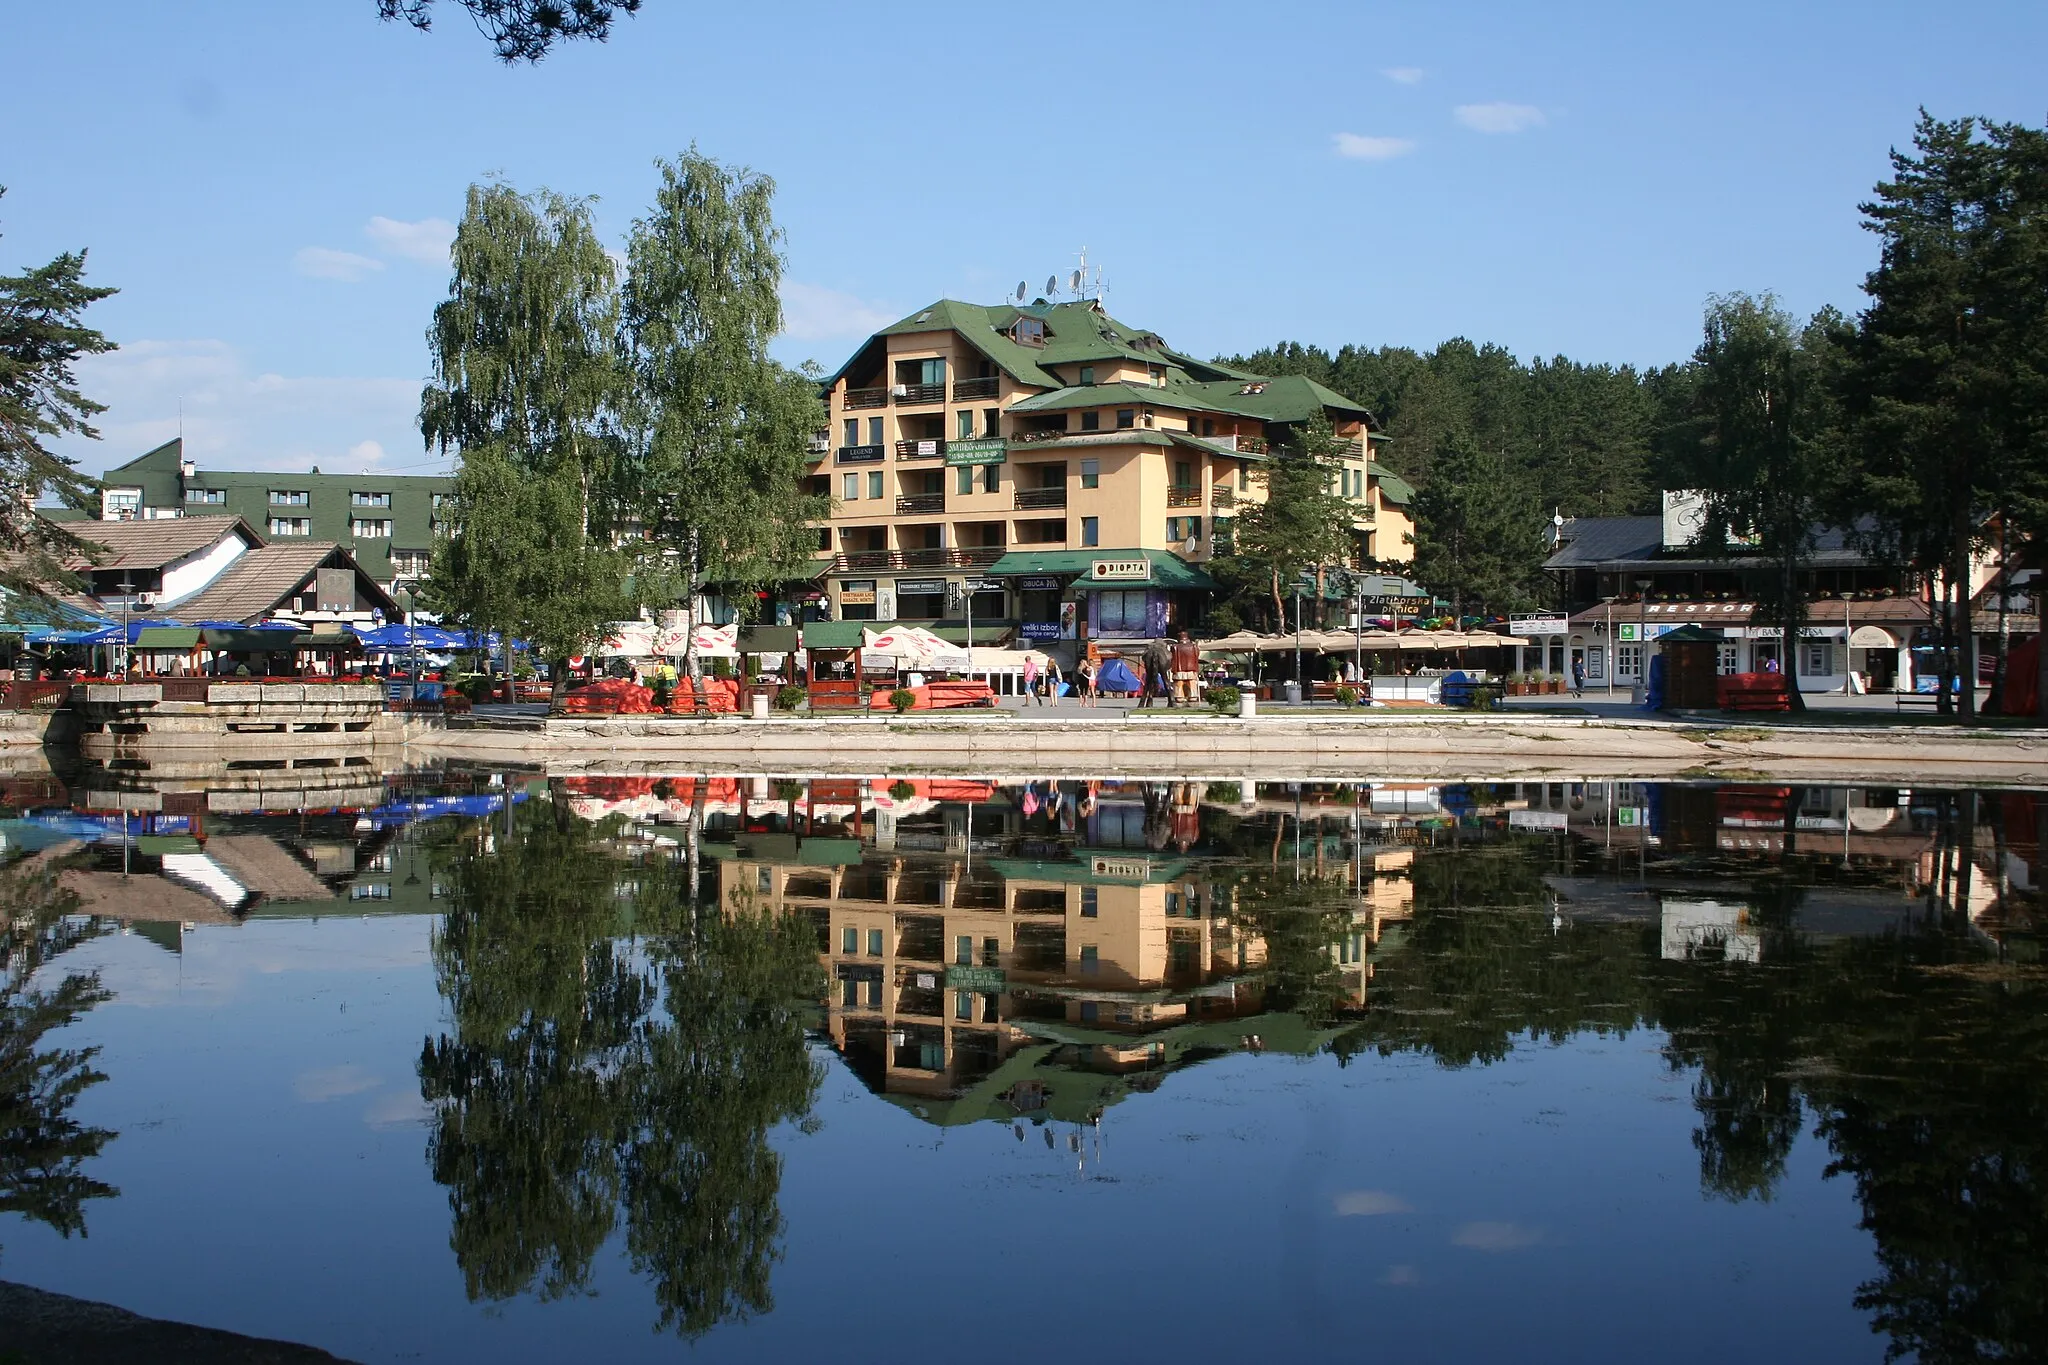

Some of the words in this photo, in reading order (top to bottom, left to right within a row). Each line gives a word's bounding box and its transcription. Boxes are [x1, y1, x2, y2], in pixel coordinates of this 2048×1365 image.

[1109, 564, 1144, 572] DIOPTA
[1369, 595, 1430, 605] Zlatiborska
[1040, 623, 1058, 631] izbor
